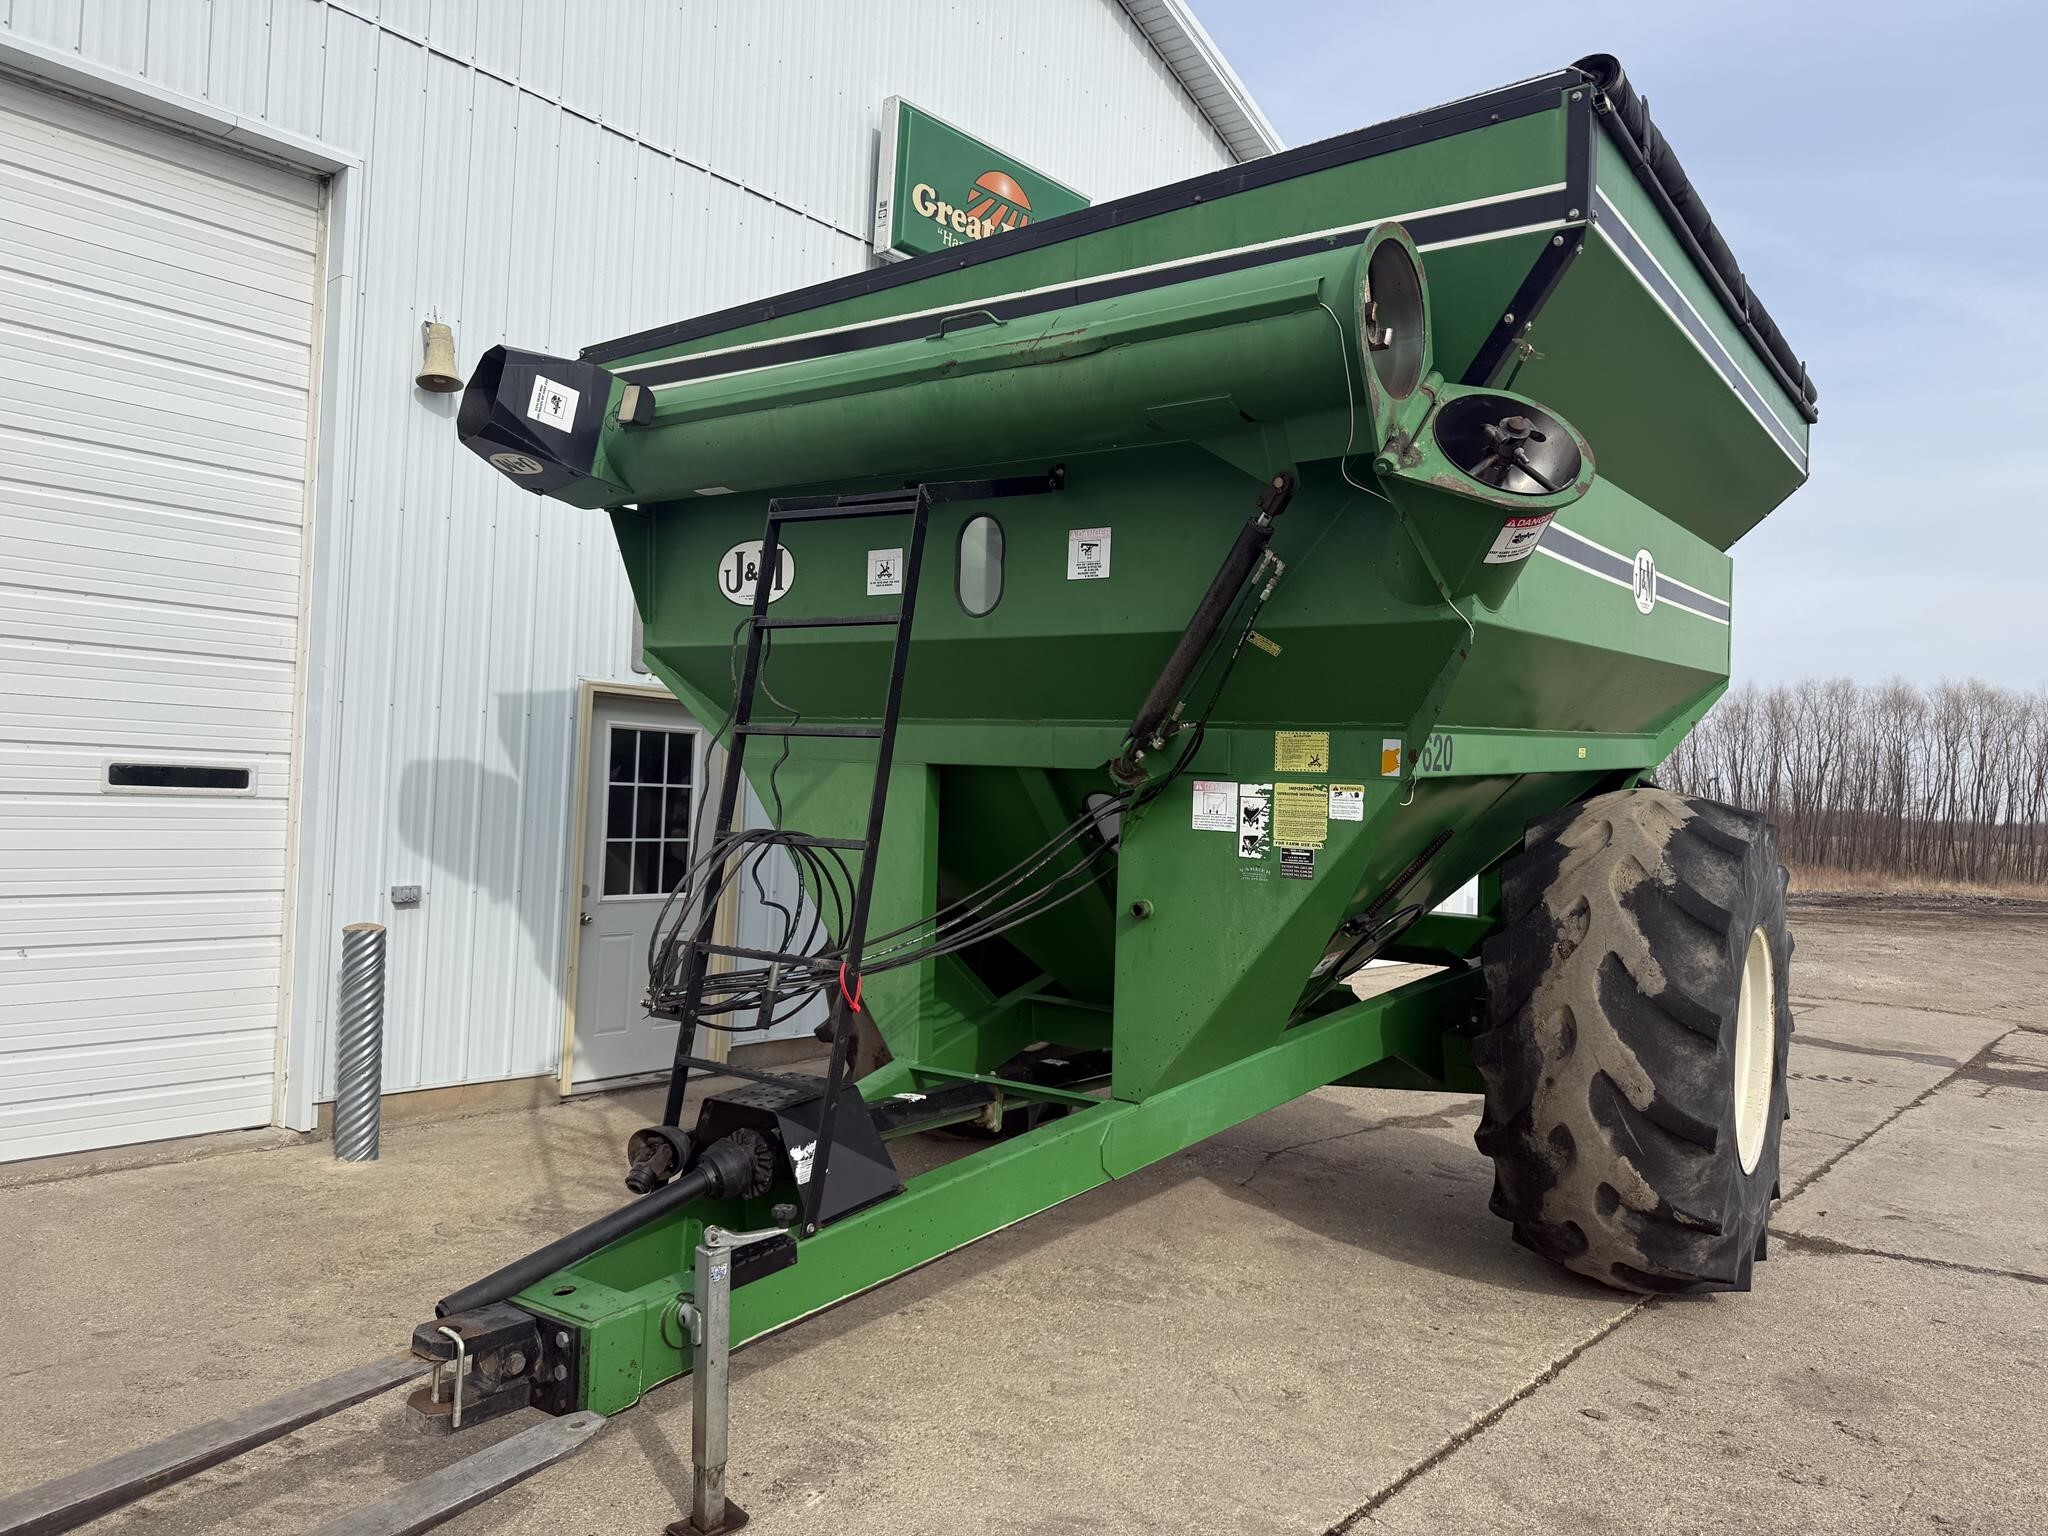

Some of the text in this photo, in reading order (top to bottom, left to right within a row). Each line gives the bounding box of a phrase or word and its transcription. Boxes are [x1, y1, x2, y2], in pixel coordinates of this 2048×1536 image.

[912, 183, 995, 240] Great
[1635, 556, 1654, 604] J&M
[1422, 734, 1454, 772] 620
